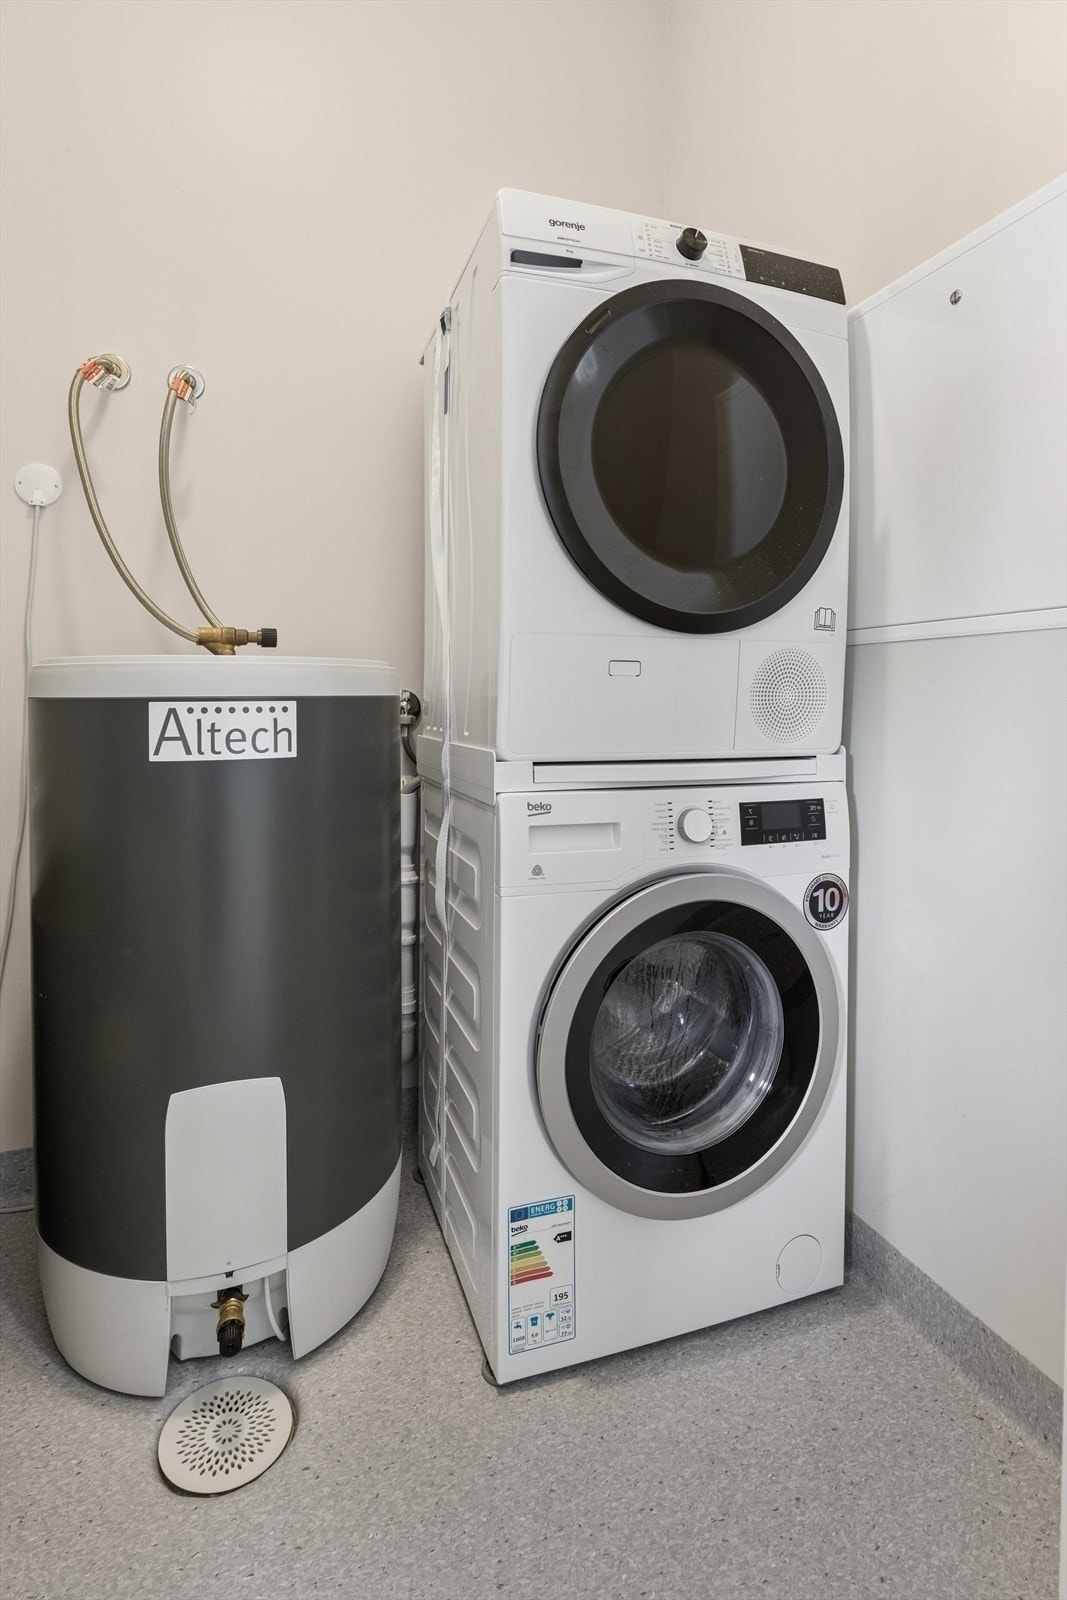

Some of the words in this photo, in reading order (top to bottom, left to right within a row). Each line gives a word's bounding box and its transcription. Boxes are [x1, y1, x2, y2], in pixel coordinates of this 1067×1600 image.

[548, 218, 586, 231] gorenje
[153, 707, 292, 757] Altech
[527, 802, 553, 812] beko
[812, 887, 841, 913] 10
[814, 919, 839, 929] WARRANTY
[530, 1202, 556, 1213] ENERG
[511, 1224, 529, 1234] beko
[553, 1291, 569, 1302] 195
